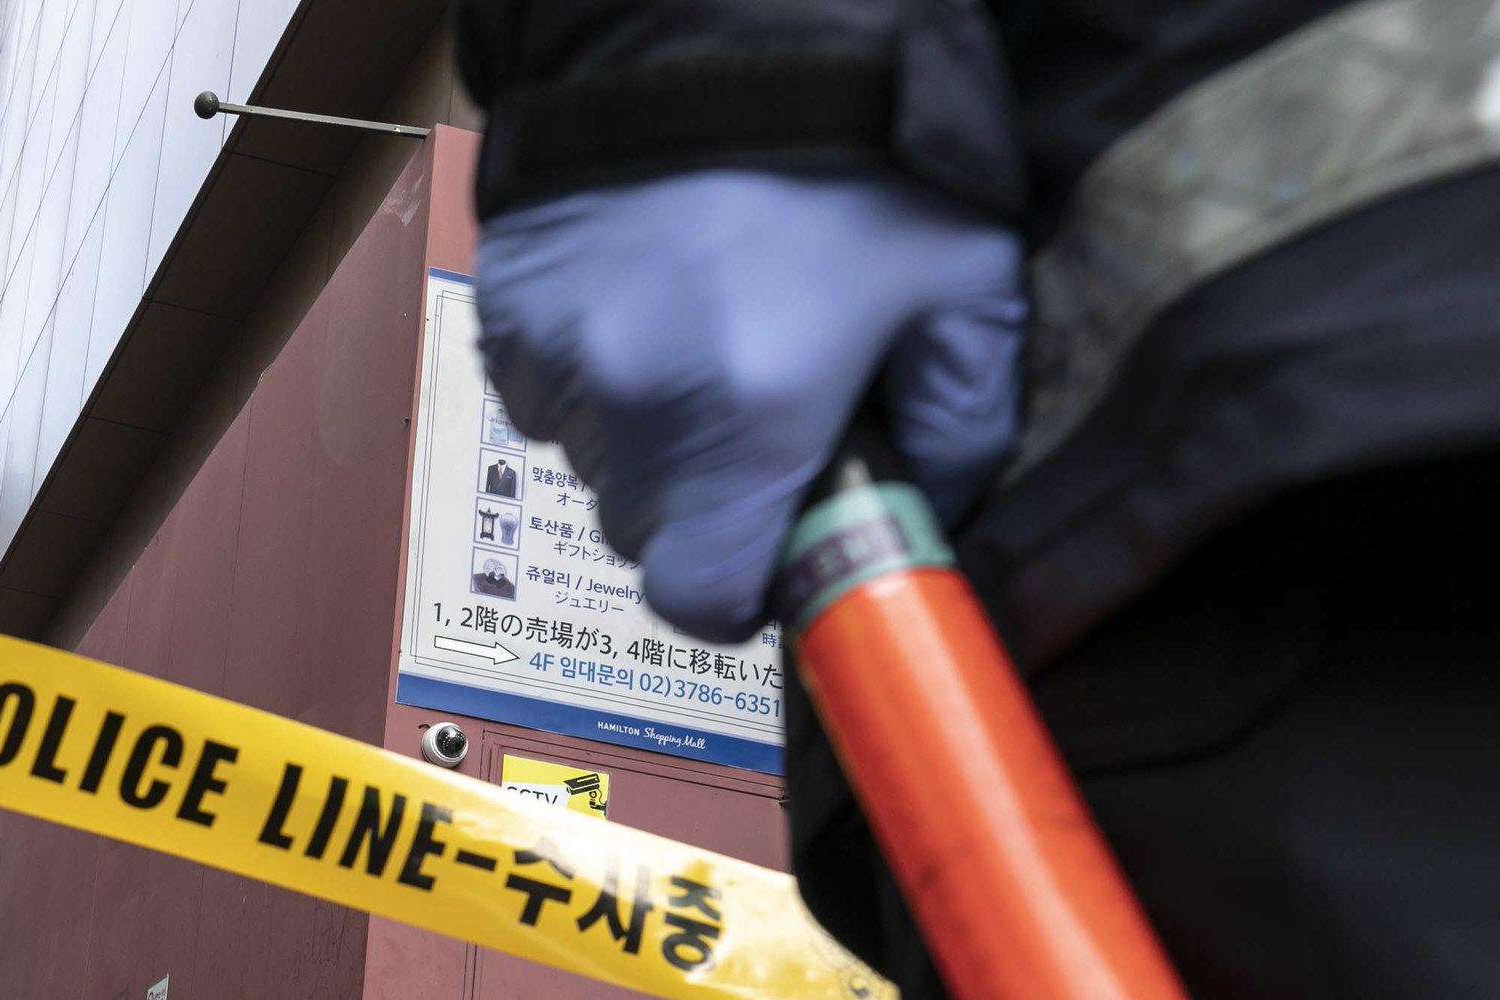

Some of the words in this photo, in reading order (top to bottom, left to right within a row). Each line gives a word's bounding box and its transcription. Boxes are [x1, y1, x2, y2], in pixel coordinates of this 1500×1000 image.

[532, 466, 579, 491] 맞춤양복
[529, 516, 574, 540] 토산품
[526, 565, 571, 589] 쥬얼리
[586, 578, 644, 605] Jewelry
[555, 590, 625, 614] ジュエリー
[529, 651, 555, 674] 4F
[560, 656, 635, 691] 임대문의
[639, 671, 782, 719] 02)3786-6351
[597, 720, 641, 737] HAMILTON
[643, 726, 682, 747] Shopping
[682, 734, 706, 750] Mall
